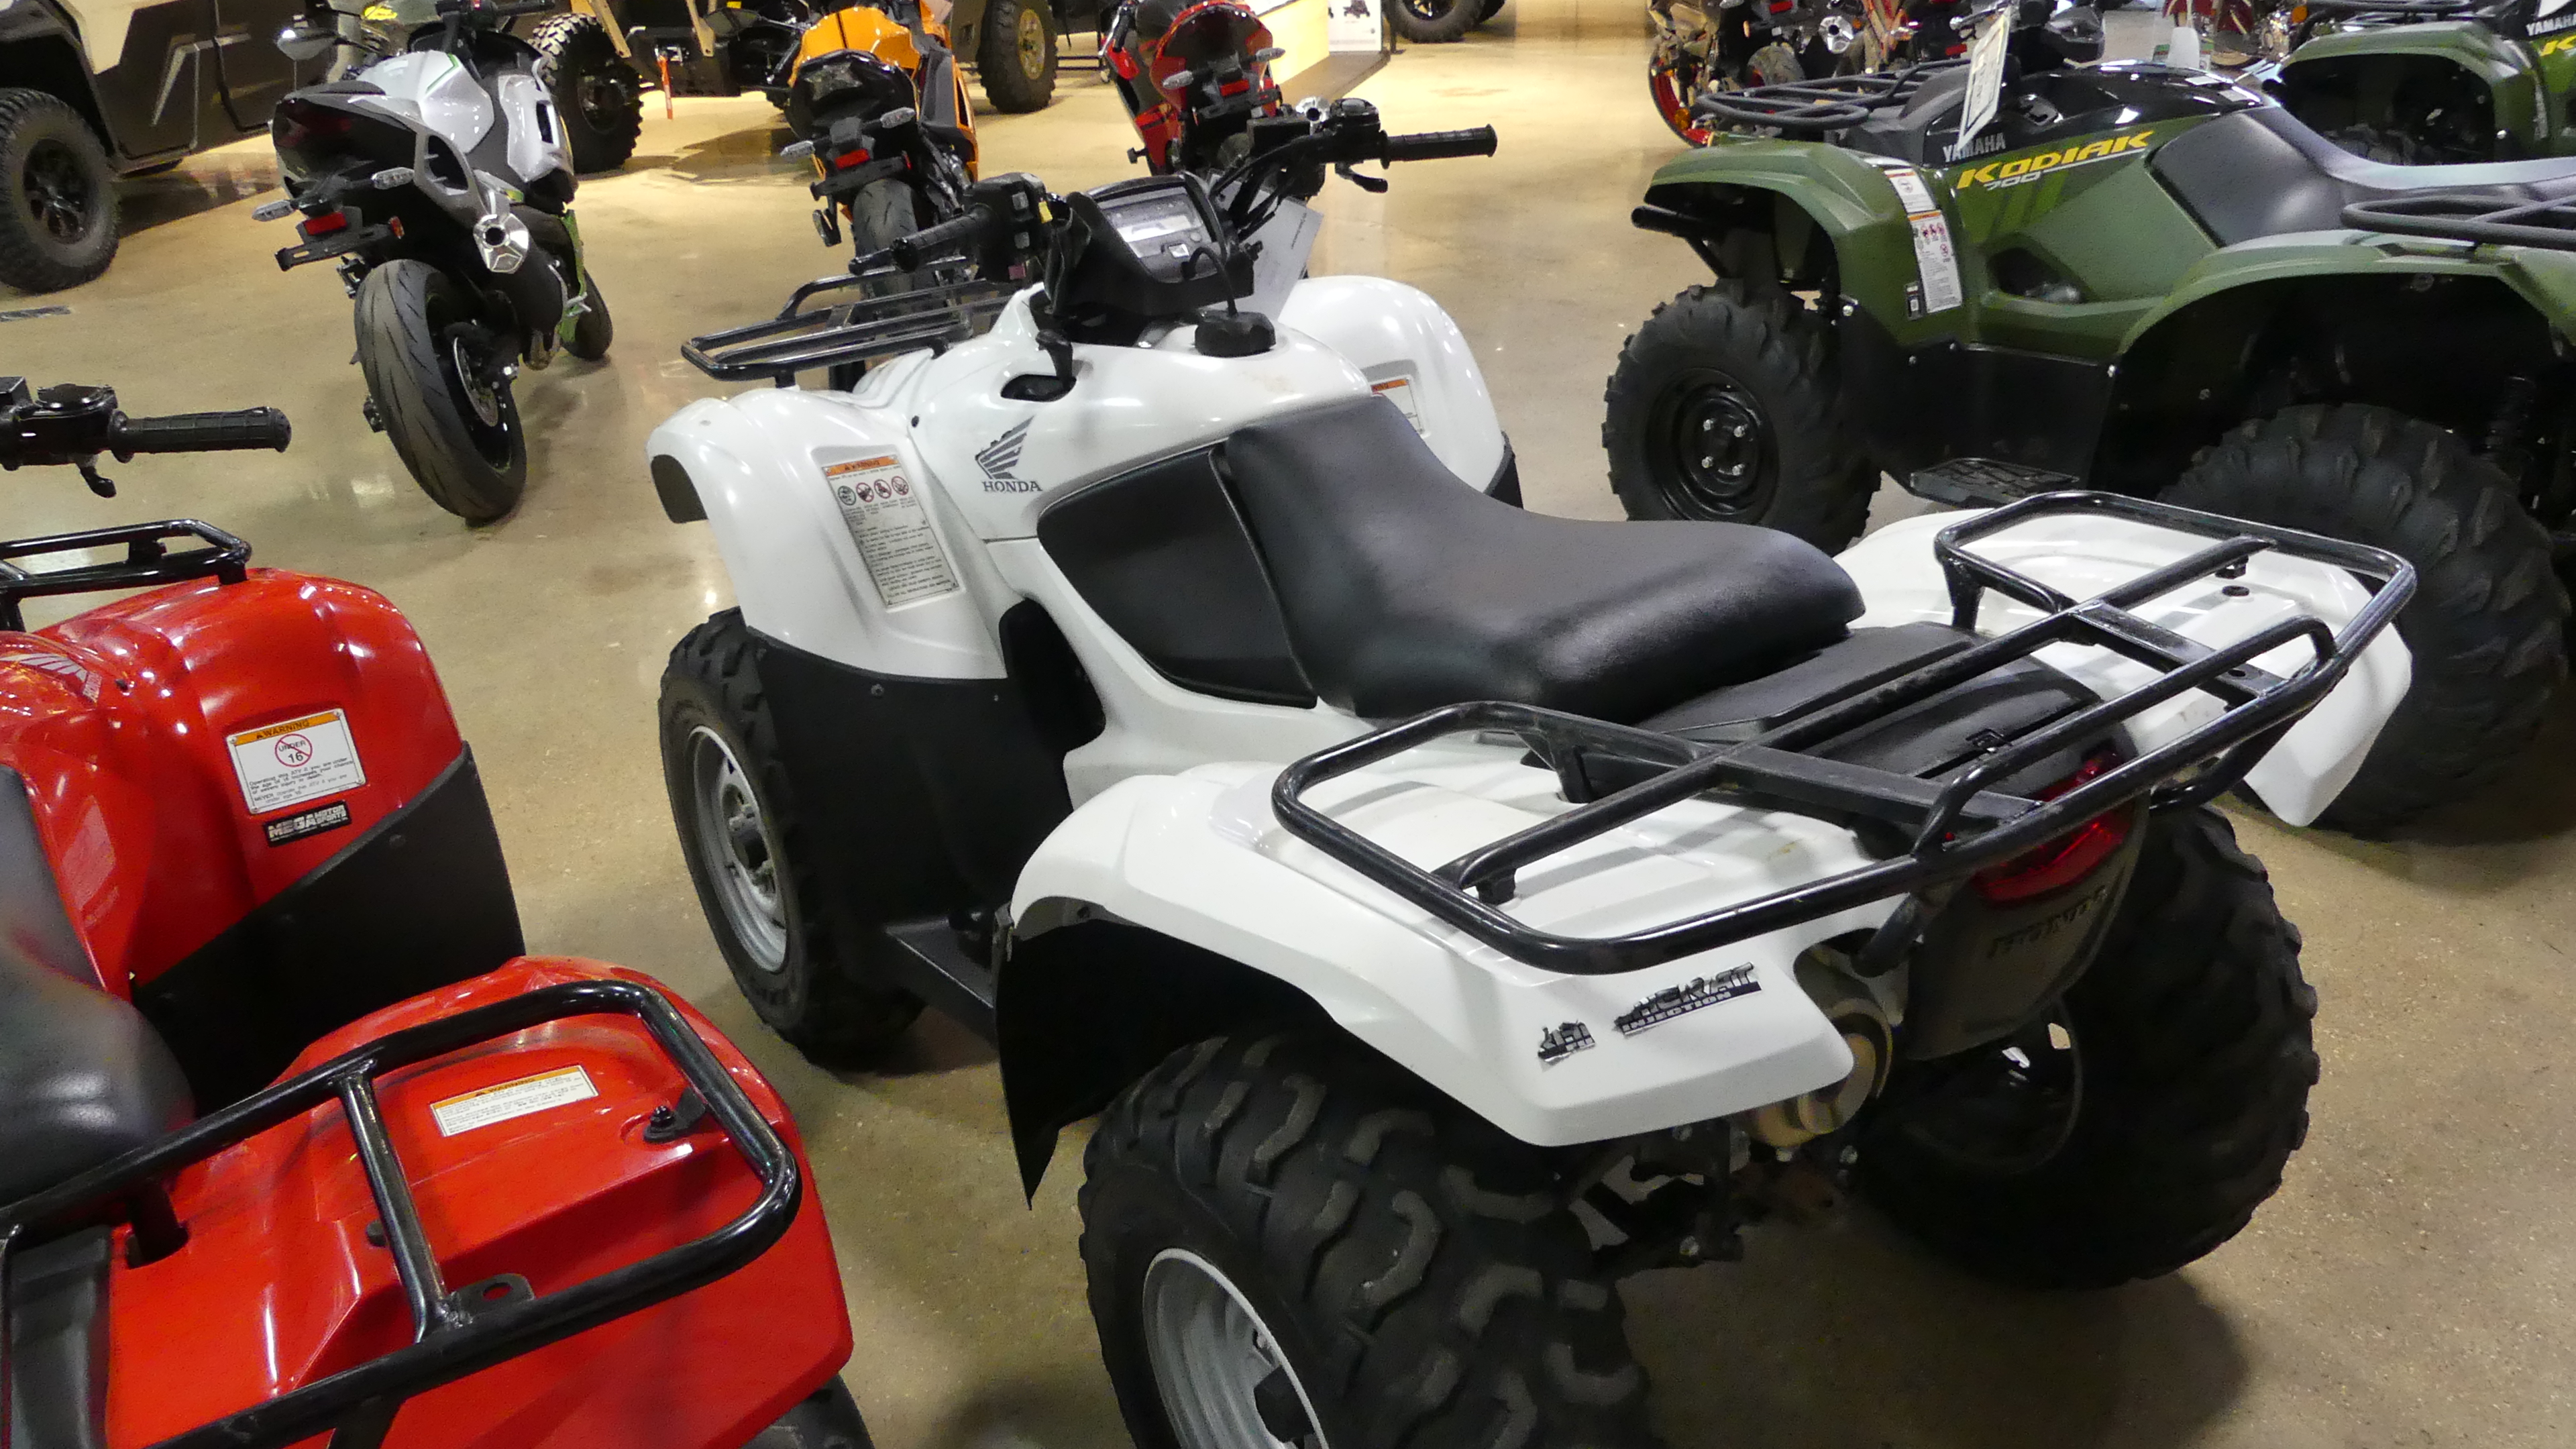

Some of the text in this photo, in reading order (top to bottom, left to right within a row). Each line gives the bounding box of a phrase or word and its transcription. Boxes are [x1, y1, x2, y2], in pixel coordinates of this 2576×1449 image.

[1957, 130, 2154, 189] KODIAK
[1984, 171, 2041, 191] 700
[981, 480, 1043, 492] HONDA
[264, 720, 309, 737] WARNING
[278, 740, 307, 752] UNDER
[288, 752, 304, 763] 16
[315, 804, 345, 818] MOTOR
[317, 810, 347, 824] SPORTS
[268, 814, 317, 838] MEGA
[1622, 991, 1731, 1032] INJECTION
[489, 1078, 535, 1093] WARNING
